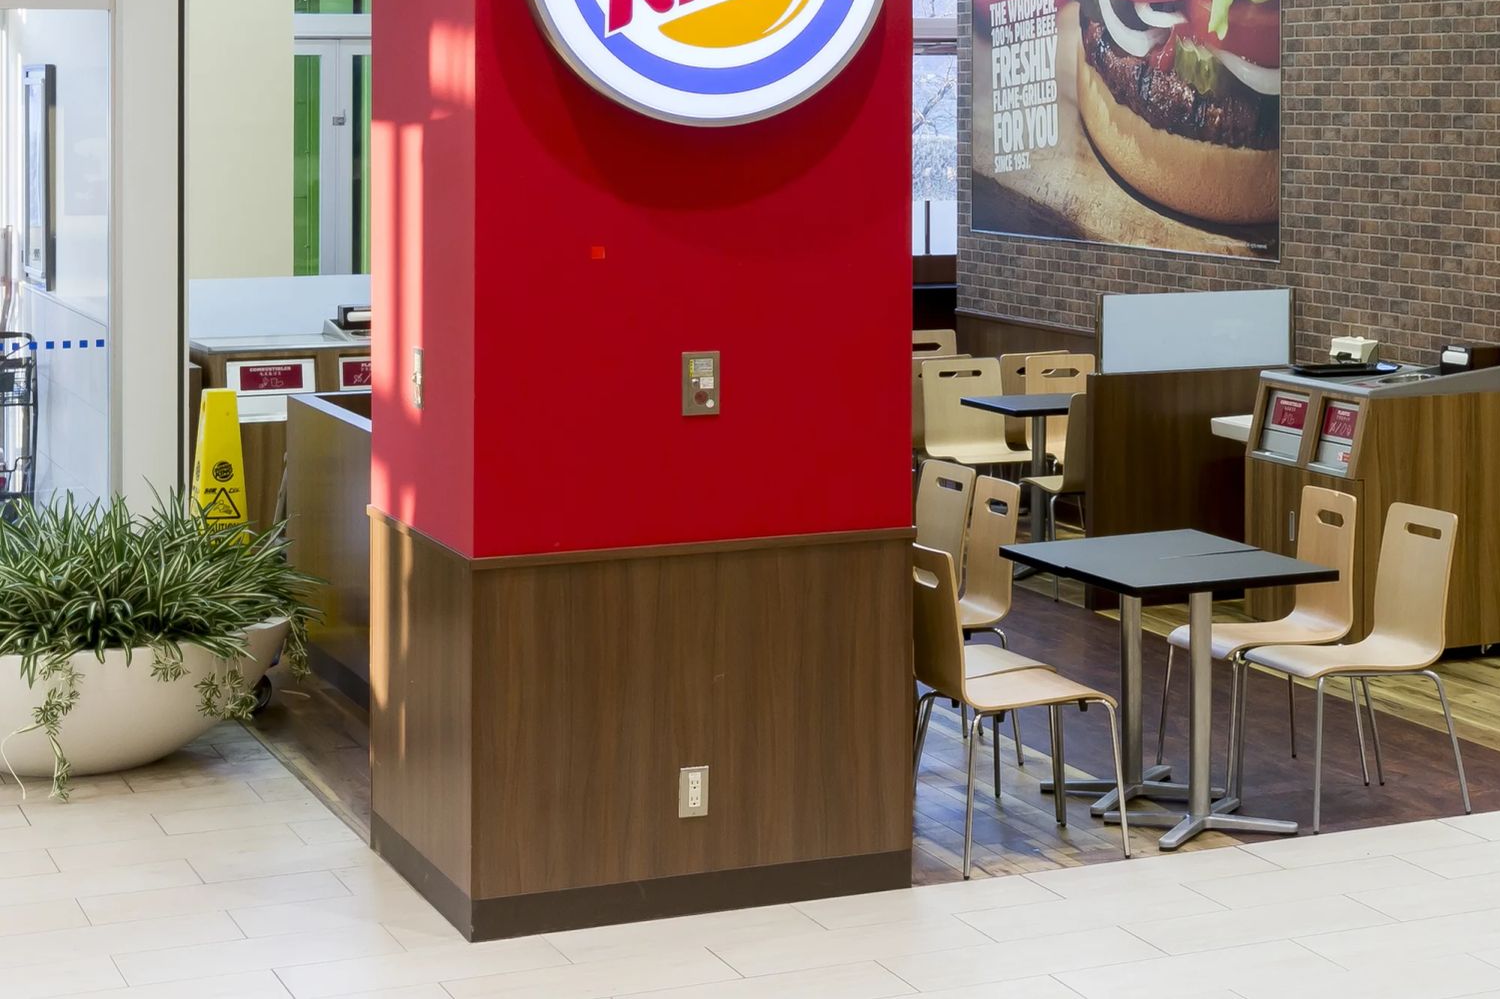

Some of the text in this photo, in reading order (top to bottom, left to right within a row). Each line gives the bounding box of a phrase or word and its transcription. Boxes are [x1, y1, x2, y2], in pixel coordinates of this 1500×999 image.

[990, 1, 1007, 26] THE
[991, 14, 1058, 47] 100% PURE BEEF.
[991, 35, 1058, 89] FRESHLY
[994, 103, 1058, 154] FOR YOU
[994, 154, 1013, 173] SINCE
